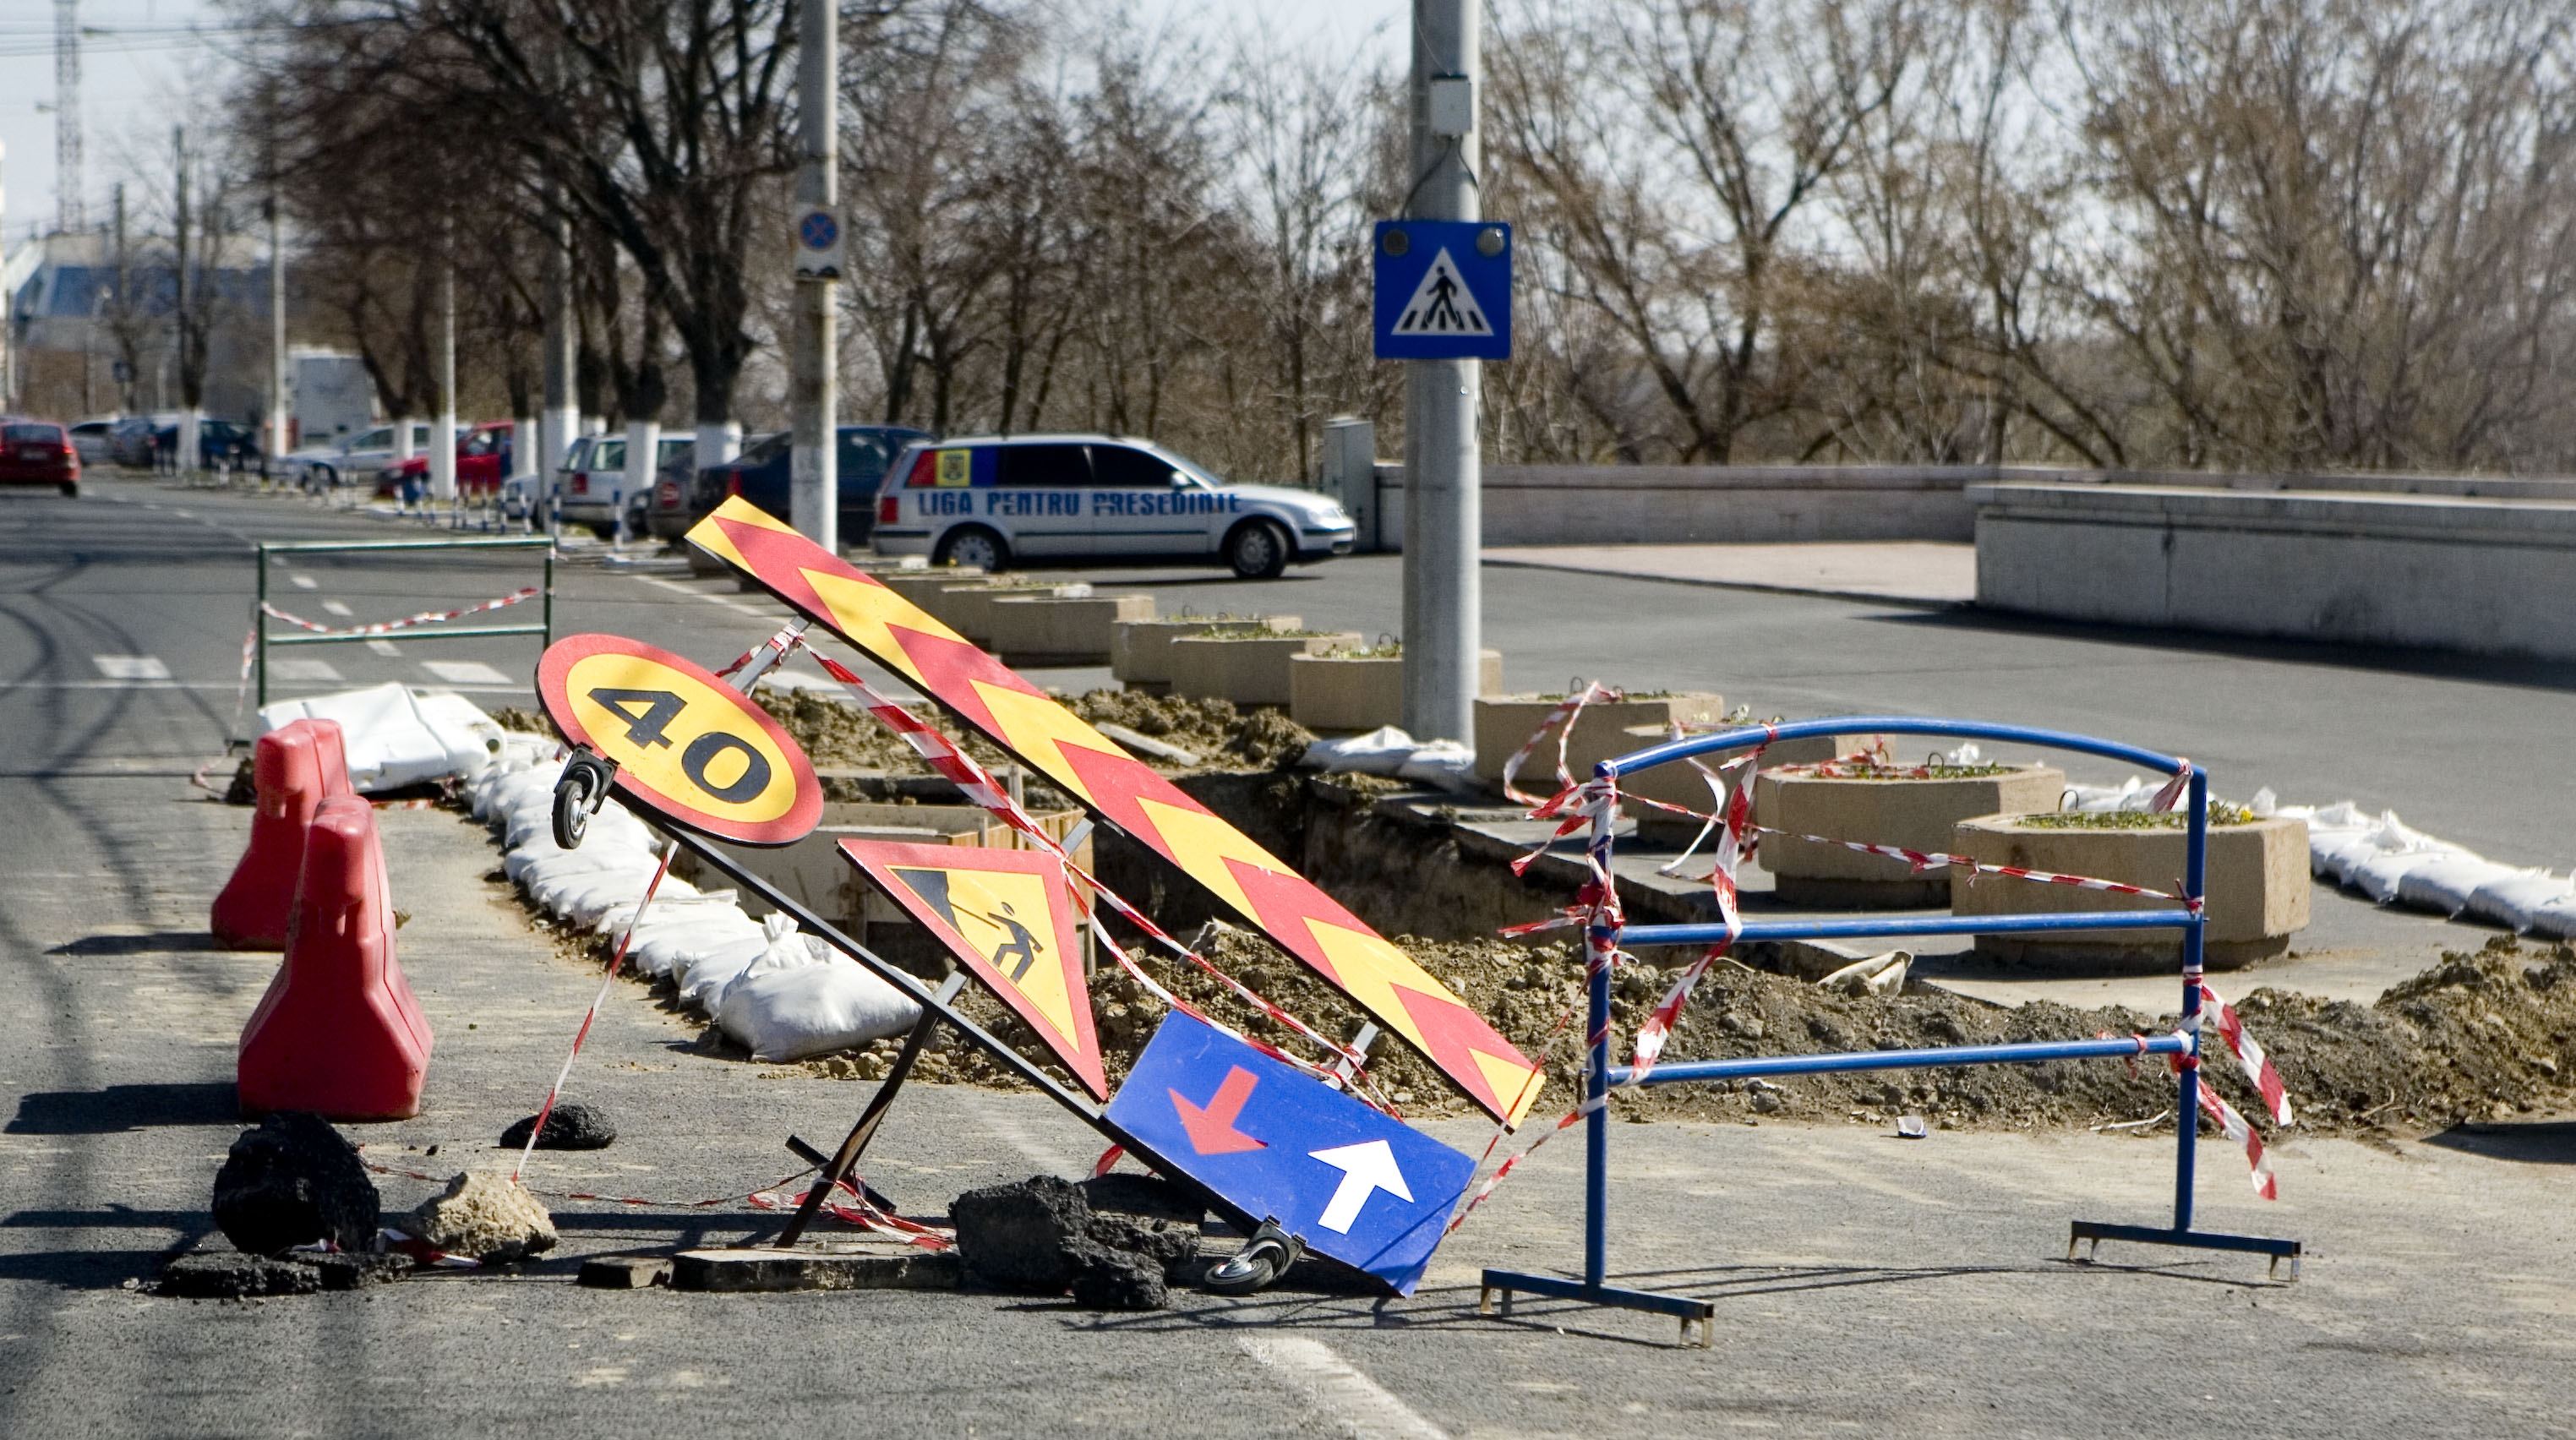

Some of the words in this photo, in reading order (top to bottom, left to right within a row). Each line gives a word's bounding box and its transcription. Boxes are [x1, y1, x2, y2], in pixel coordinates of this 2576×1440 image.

[919, 492, 972, 516] LIGA
[987, 492, 1080, 516] PENTRU
[587, 688, 771, 804] 40
